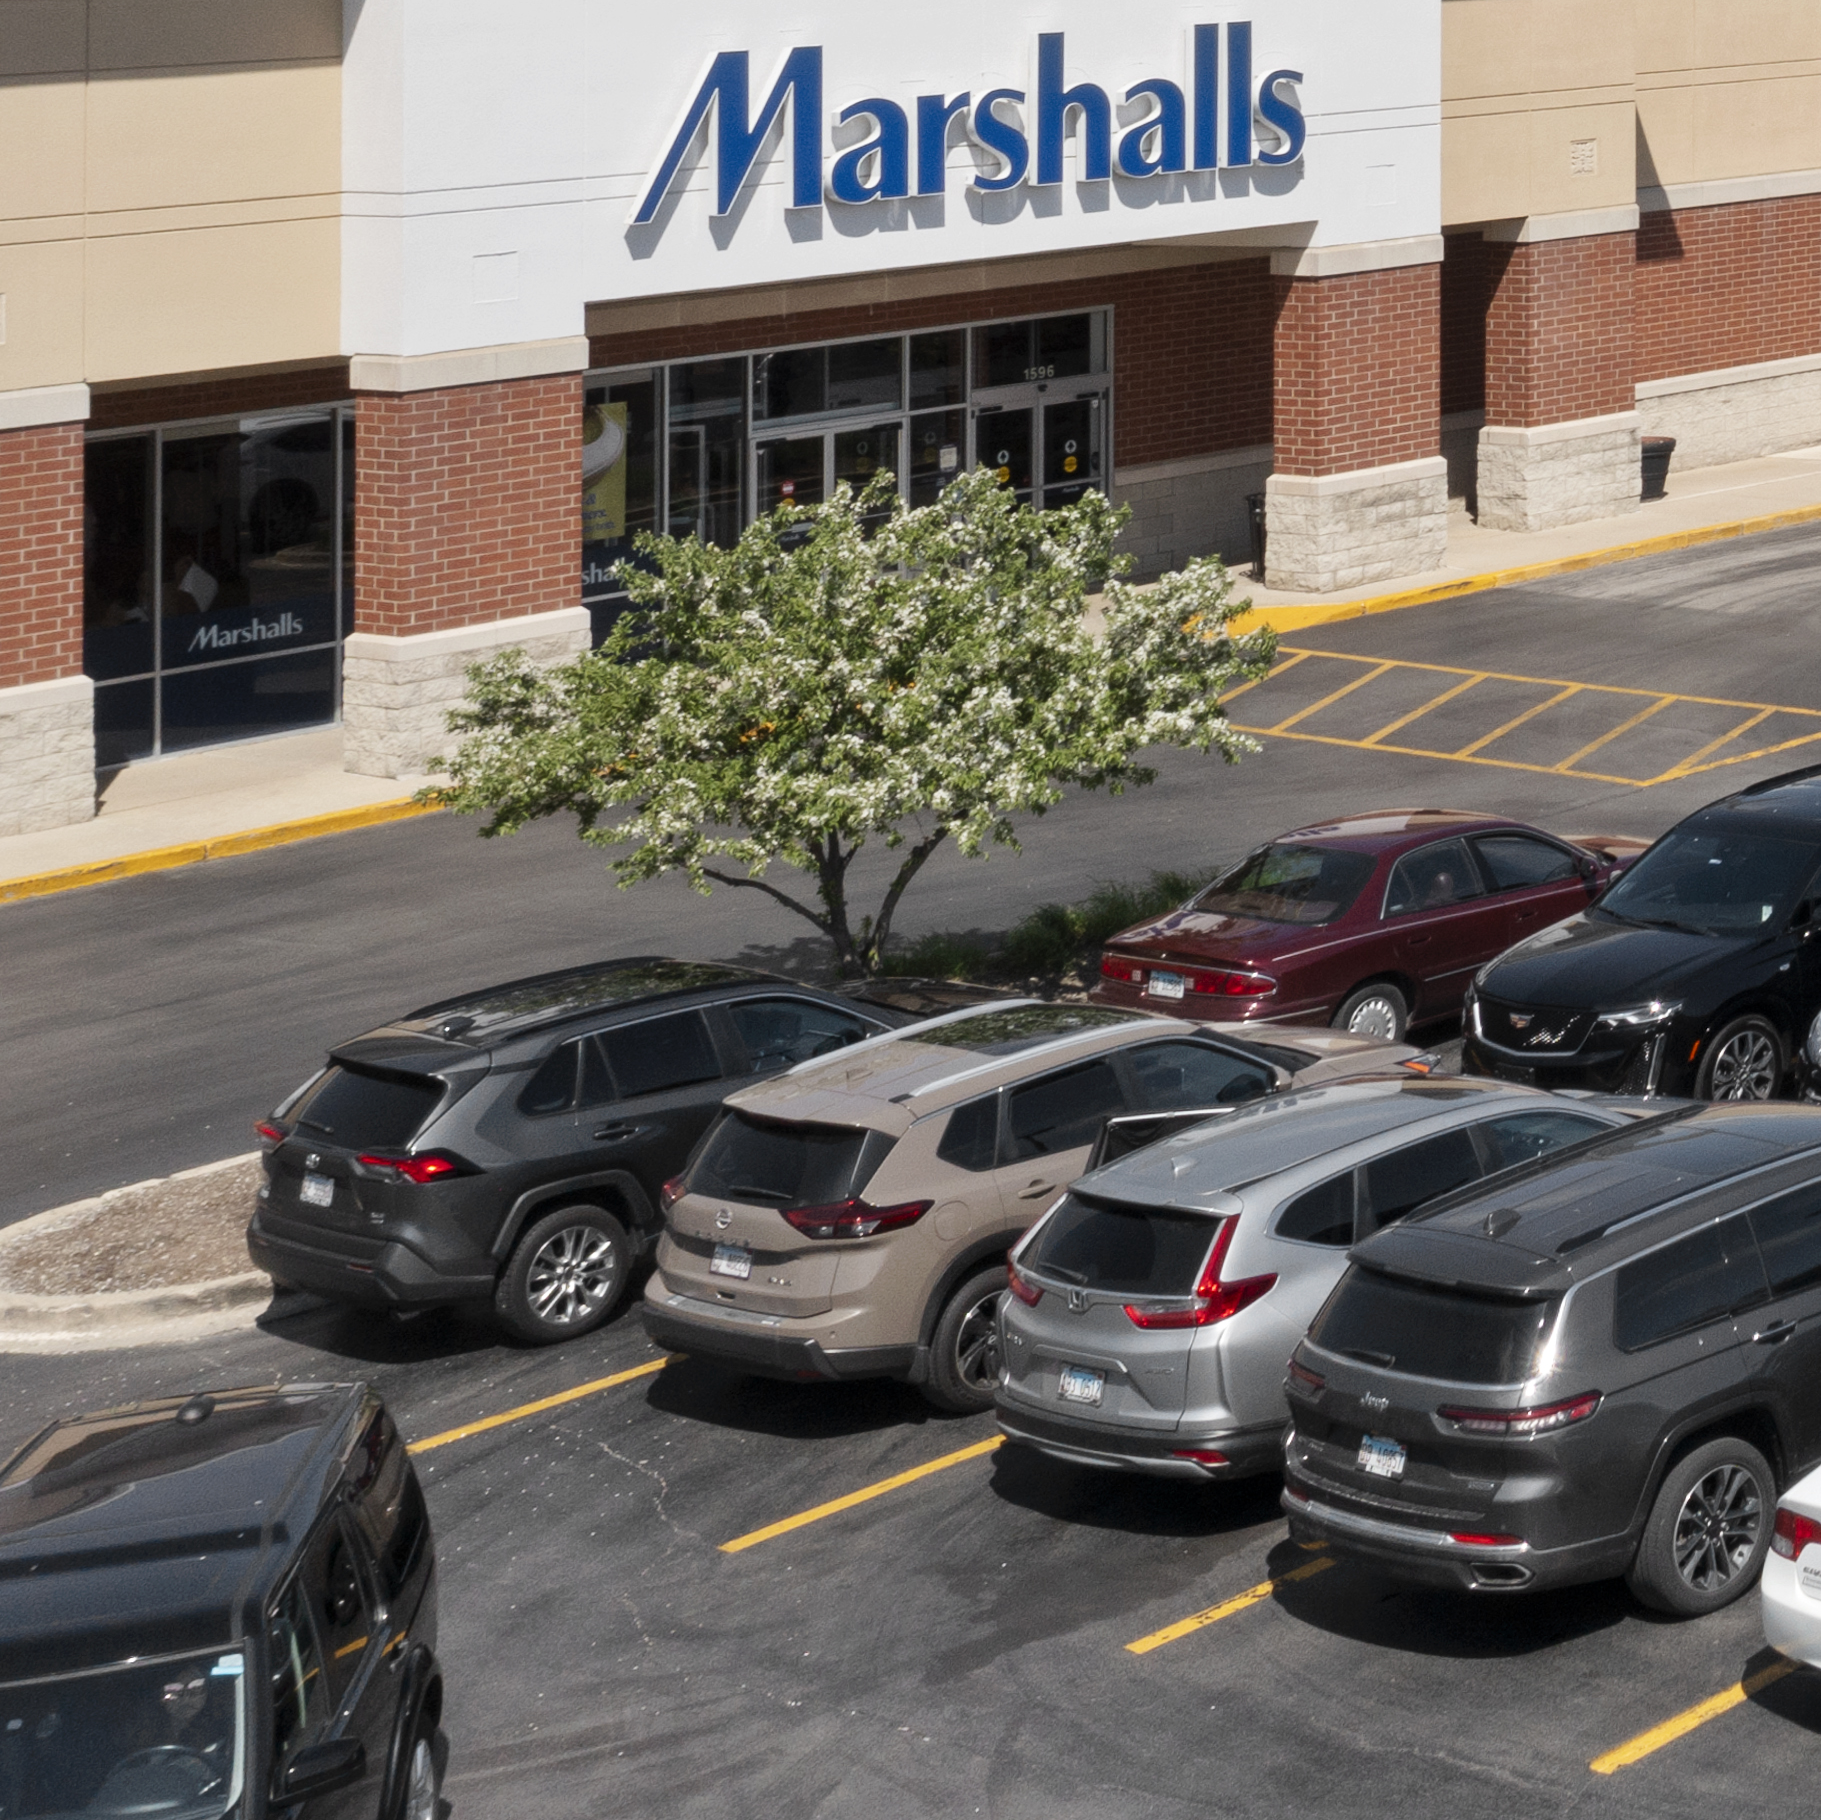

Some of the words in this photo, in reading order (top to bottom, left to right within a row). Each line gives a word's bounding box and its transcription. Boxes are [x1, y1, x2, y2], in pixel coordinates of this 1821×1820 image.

[627, 20, 1306, 226] Marshalls
[1023, 364, 1055, 381] 1596
[188, 612, 303, 652] Marshalls
[1360, 1390, 1390, 1411] Jeep
